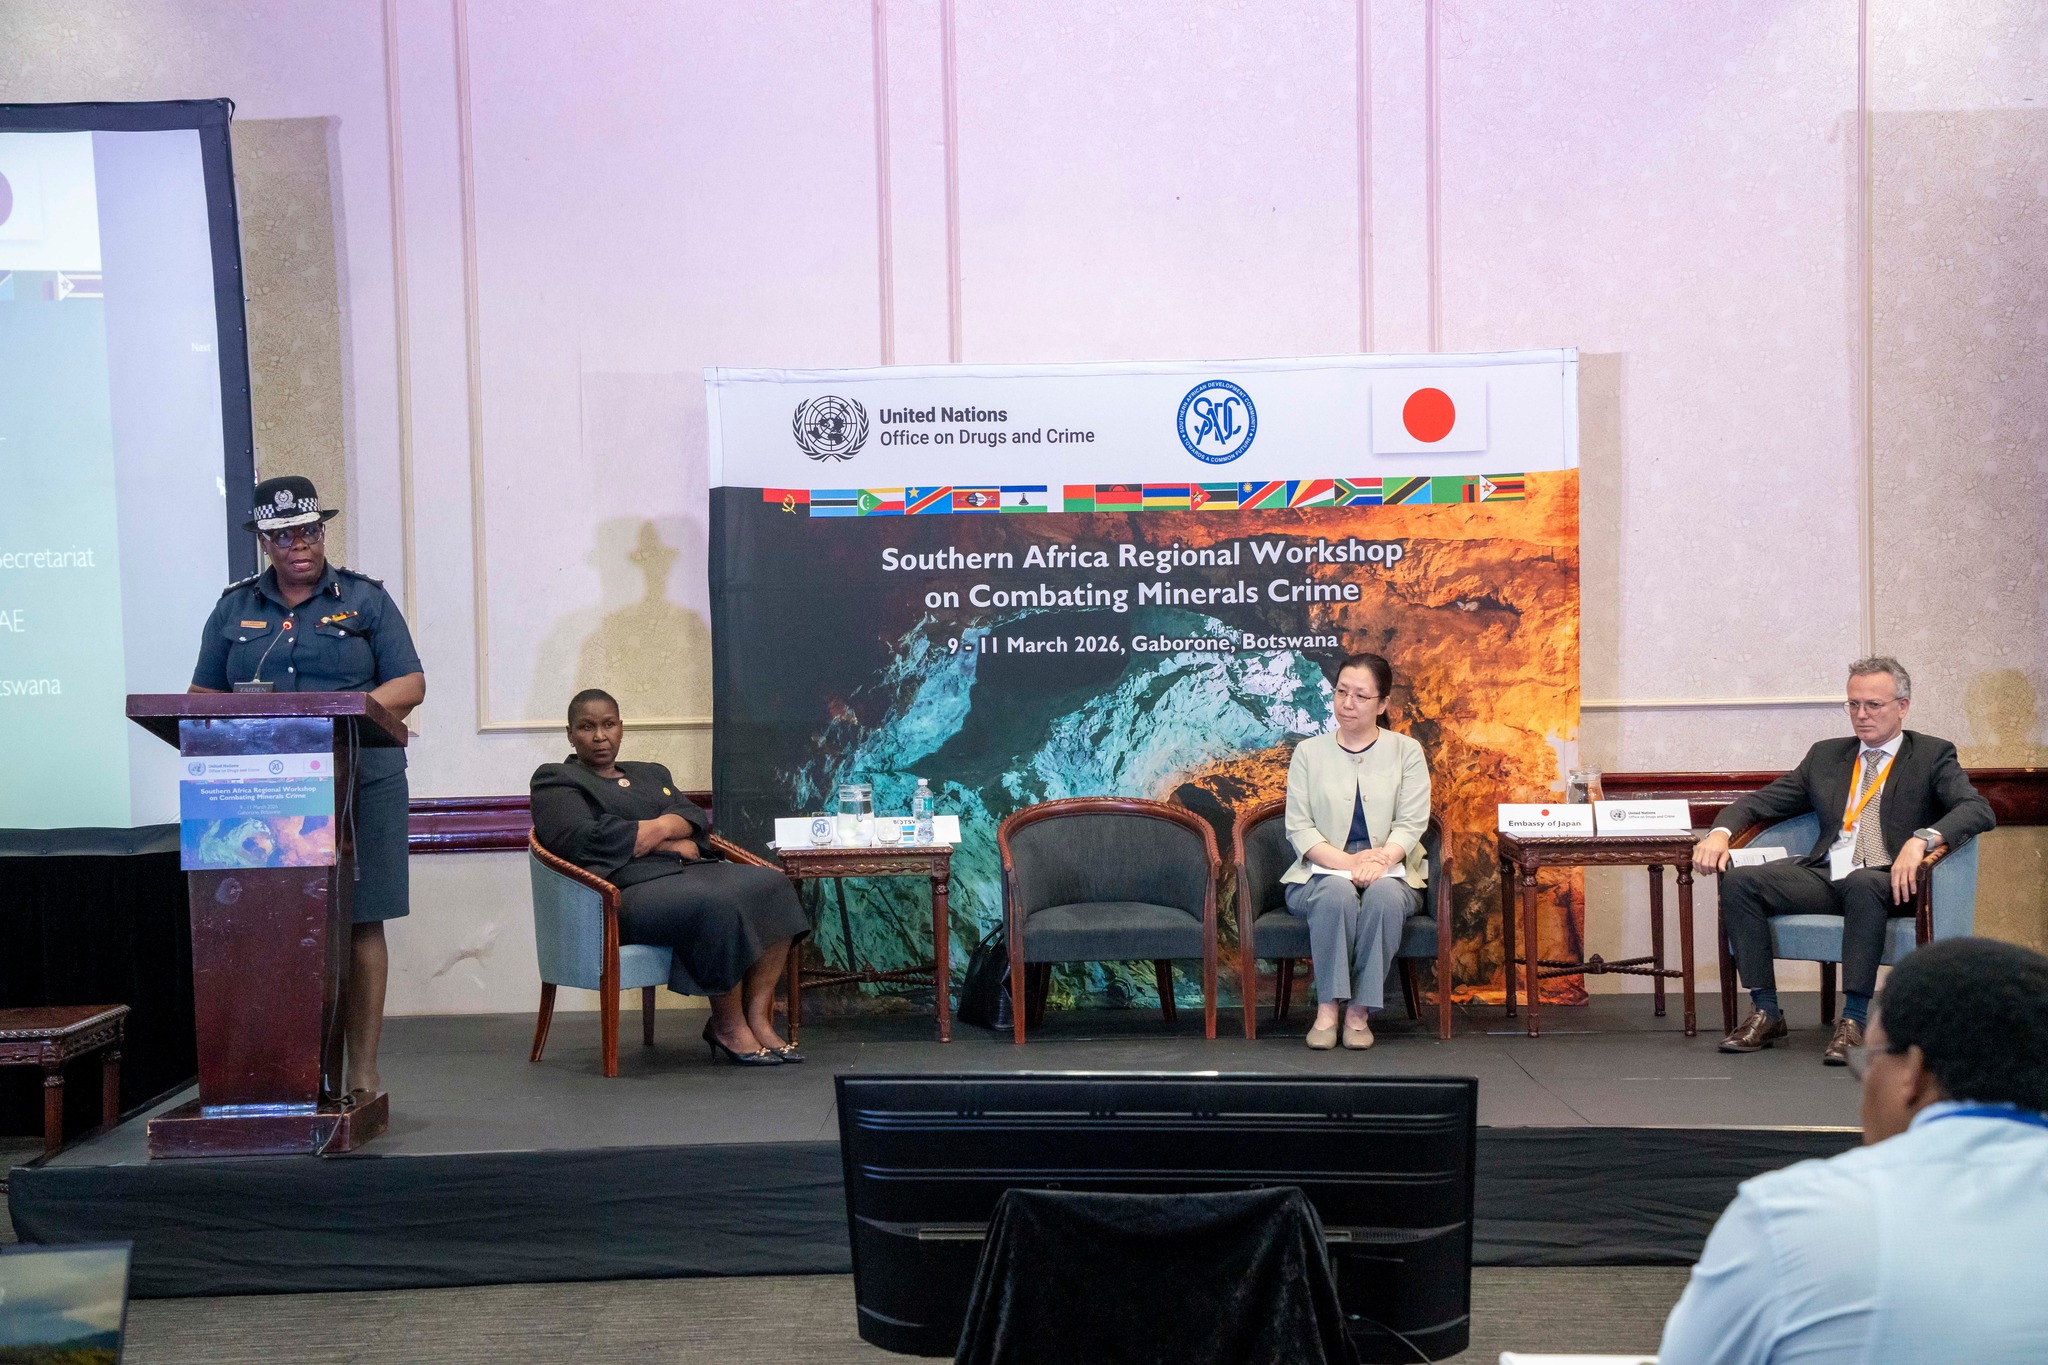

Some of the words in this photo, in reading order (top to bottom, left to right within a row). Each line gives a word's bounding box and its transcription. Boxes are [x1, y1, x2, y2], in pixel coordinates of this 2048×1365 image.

[880, 406, 936, 424] United
[941, 406, 1008, 422] Nations
[1178, 401, 1188, 434] SOUTHERN
[1186, 384, 1207, 402] AFRICAN
[1208, 382, 1246, 398] DEVELOPMENT
[1244, 398, 1256, 432] COMMUNITY
[880, 430, 929, 446] Office
[934, 432, 954, 444] on
[960, 429, 1007, 448] Drugs
[1012, 428, 1041, 444] and
[1046, 428, 1095, 444] Crime
[1184, 438, 1204, 460] TOWARDS
[1210, 453, 1236, 462] COMMON
[1235, 438, 1252, 456] FUTURE
[882, 546, 1014, 572] Southern
[1022, 544, 1110, 569] Africa
[1118, 542, 1240, 574] Regional
[1250, 538, 1402, 568] Workshop
[924, 590, 960, 608] on
[968, 583, 1129, 613] Combating
[1138, 580, 1259, 606] Minerals
[1268, 578, 1360, 602] Crime
[948, 637, 959, 654] 9
[980, 636, 998, 654] 11
[1006, 636, 1068, 653] March
[1074, 635, 1126, 656] 2026,
[1131, 634, 1236, 653] Gaborone,
[1242, 633, 1338, 650] Botswana
[253, 786, 282, 794] Regional
